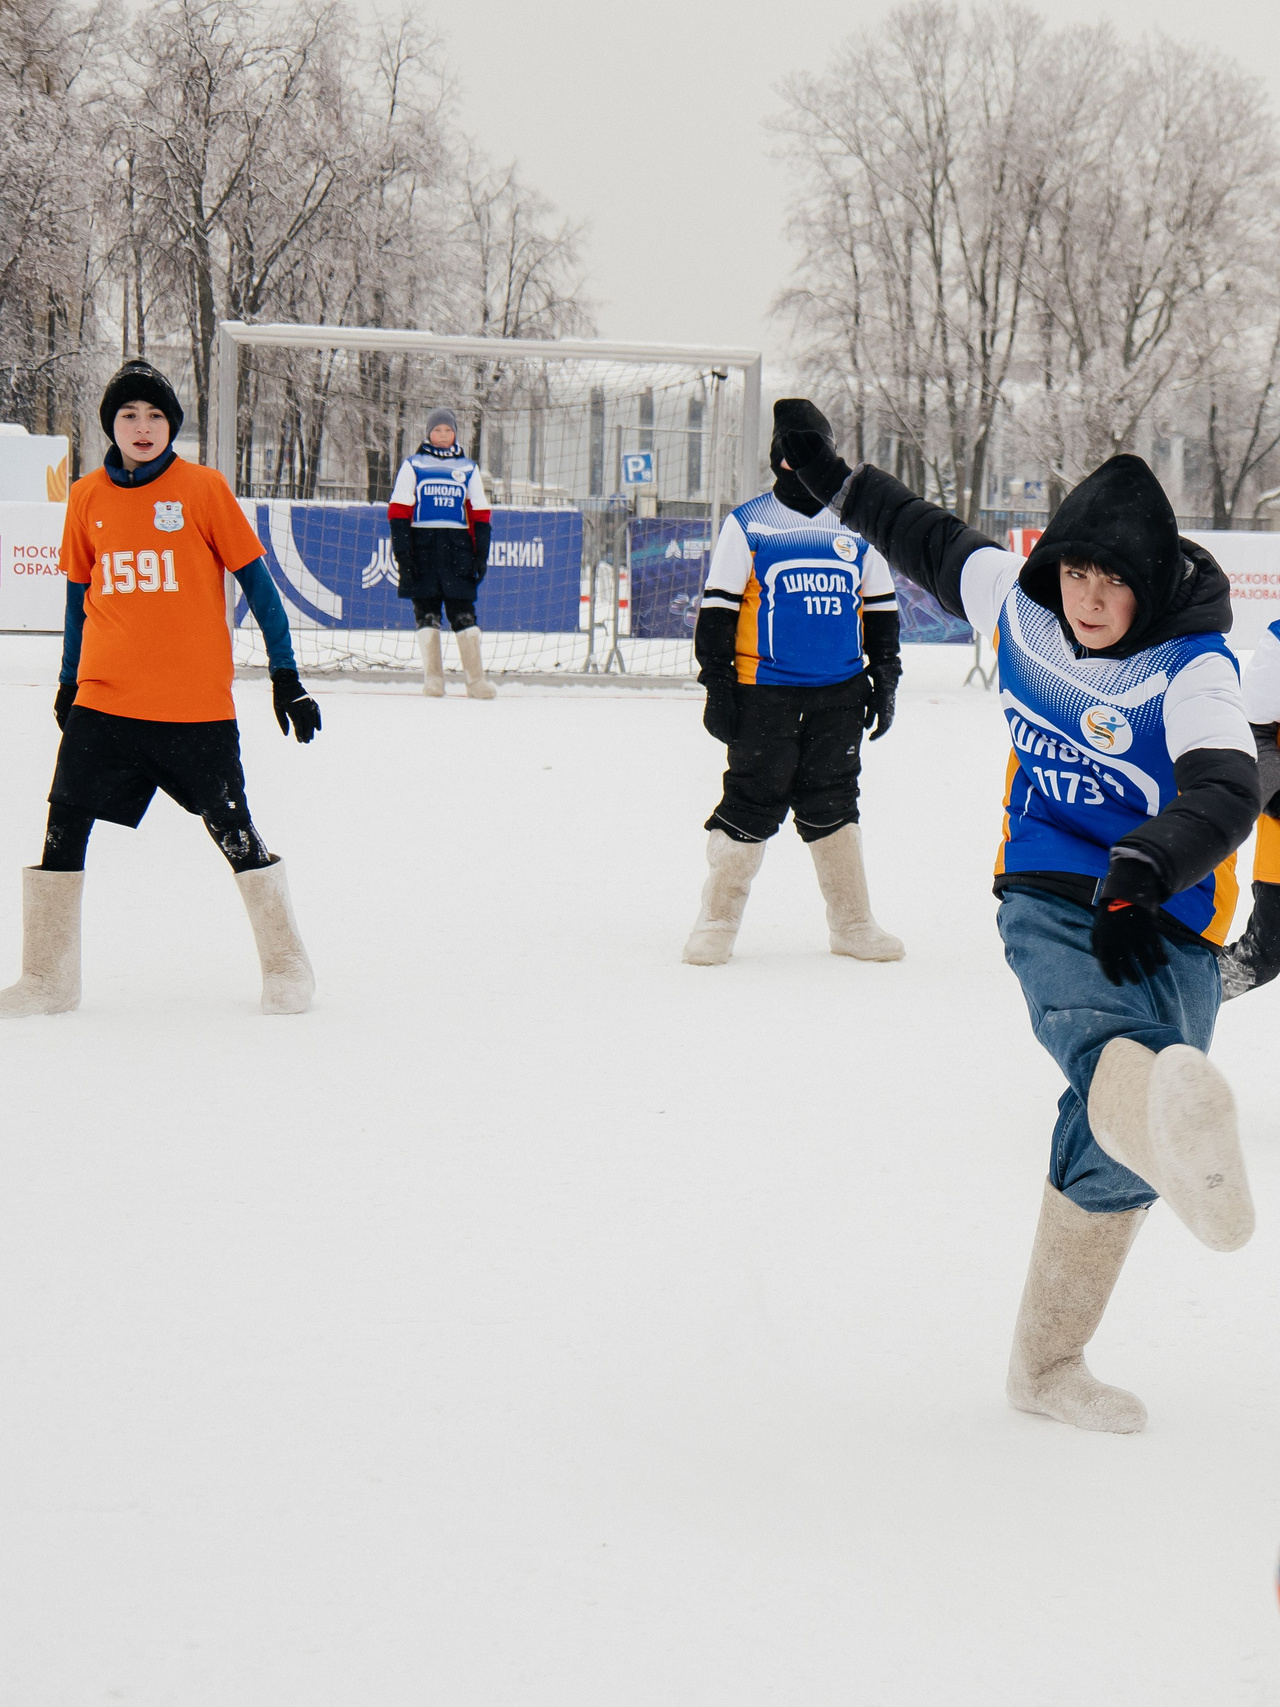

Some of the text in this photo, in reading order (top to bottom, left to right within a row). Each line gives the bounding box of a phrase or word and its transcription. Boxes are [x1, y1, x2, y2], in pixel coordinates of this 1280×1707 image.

[423, 485, 462, 497] ШКОЛА
[433, 496, 455, 507] 1173
[13, 546, 62, 558] МОСК
[101, 550, 179, 595] 1591
[803, 596, 842, 615] 1173
[1032, 766, 1104, 805] 1173
